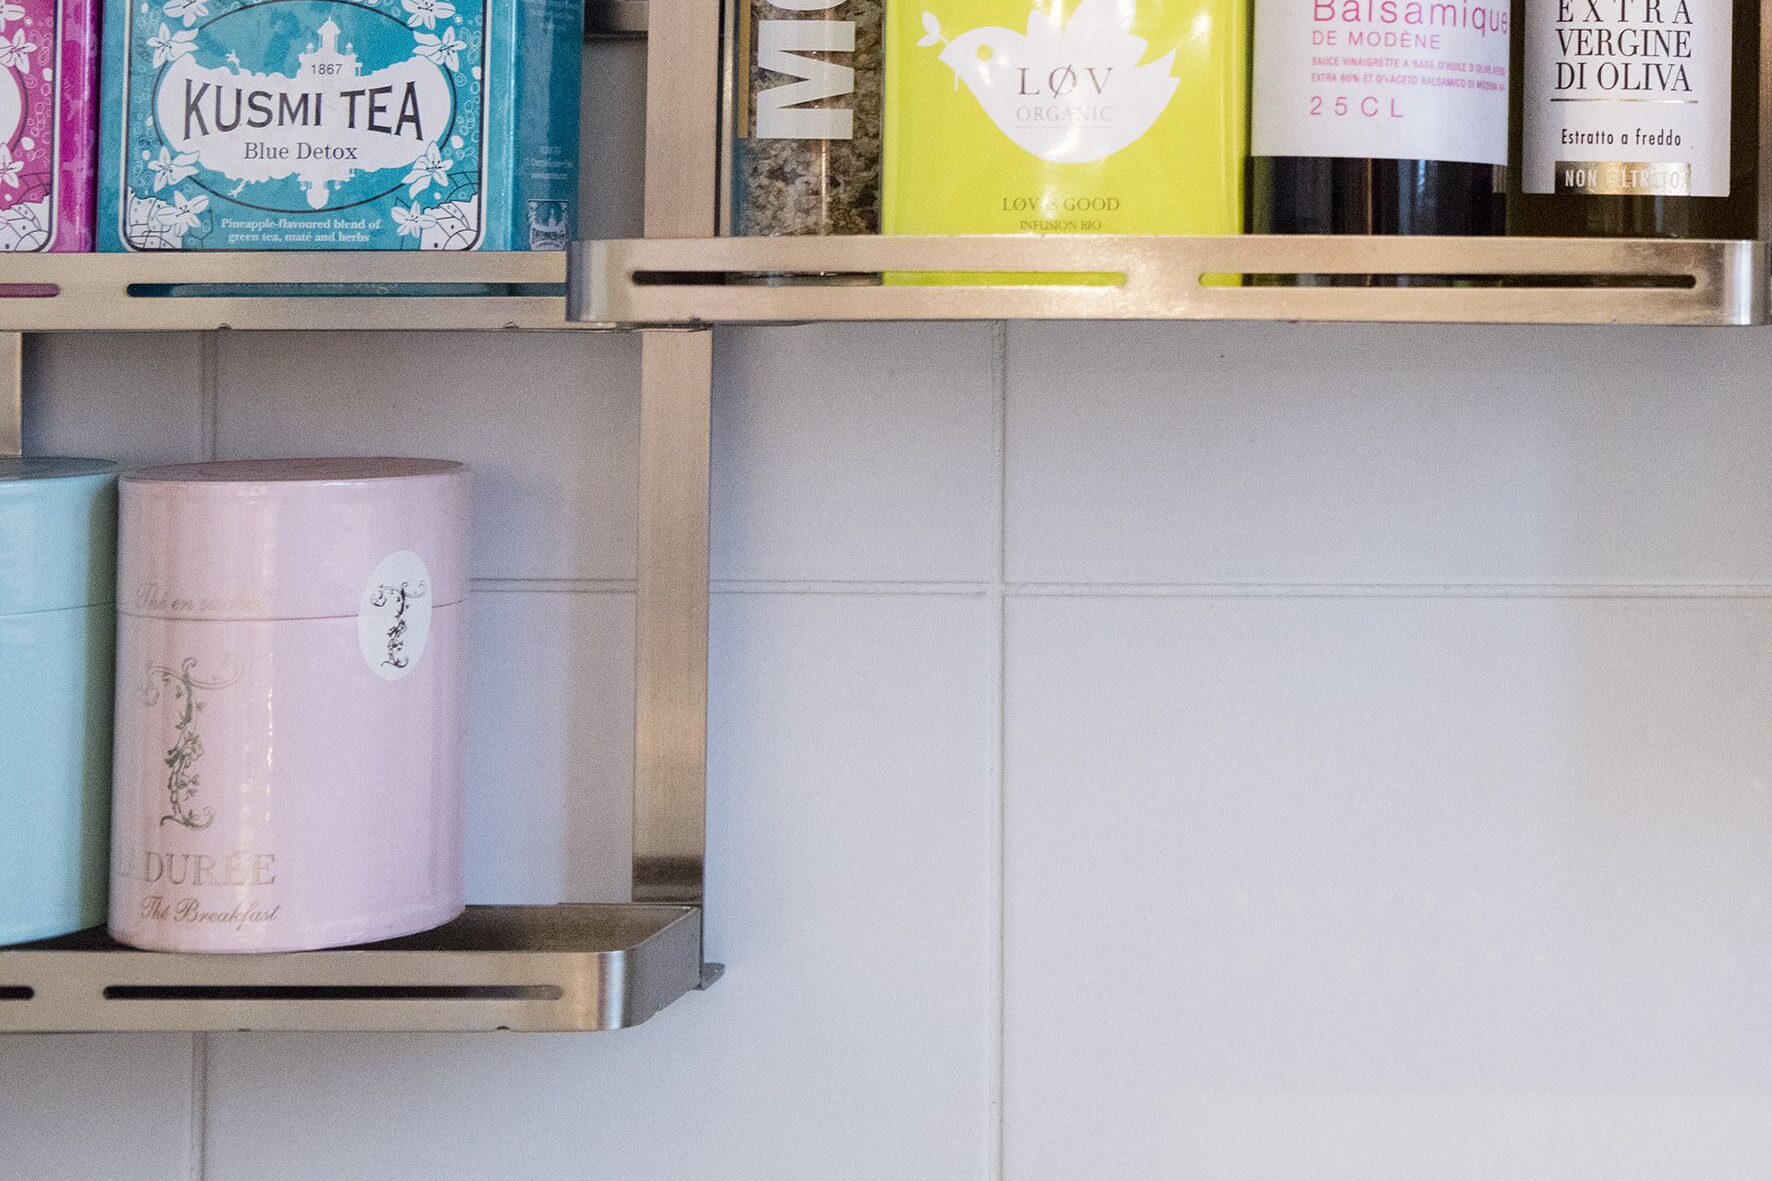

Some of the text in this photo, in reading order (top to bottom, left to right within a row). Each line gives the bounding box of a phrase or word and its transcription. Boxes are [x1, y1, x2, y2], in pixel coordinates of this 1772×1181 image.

[1312, 30, 1441, 50] DE MODÈNE
[1555, 28, 1693, 58] VERGINE
[311, 64, 342, 75] 1867
[1311, 57, 1339, 67] SAUCE
[1343, 57, 1400, 69] VINAIGRETTE
[1413, 60, 1435, 70] BASE
[1017, 63, 1114, 99] LØV
[1311, 73, 1337, 83] EXTRA
[1421, 77, 1466, 89] BALSAMICO
[1555, 61, 1694, 92] DI OLIVA
[183, 78, 424, 141] KUSMI TEA
[1016, 105, 1113, 122] ORGANIC
[1561, 127, 1682, 147] Estratto a freddo
[244, 142, 358, 160] Blue Detox
[1564, 168, 1598, 188] NON
[1064, 196, 1120, 212] GOOD
[221, 219, 381, 233] Pineapple-flavoured blend of
[1019, 219, 1102, 231] INFUSION BIO
[228, 231, 370, 244] green tea, maté and herbs
[173, 897, 281, 932] Breakfast
